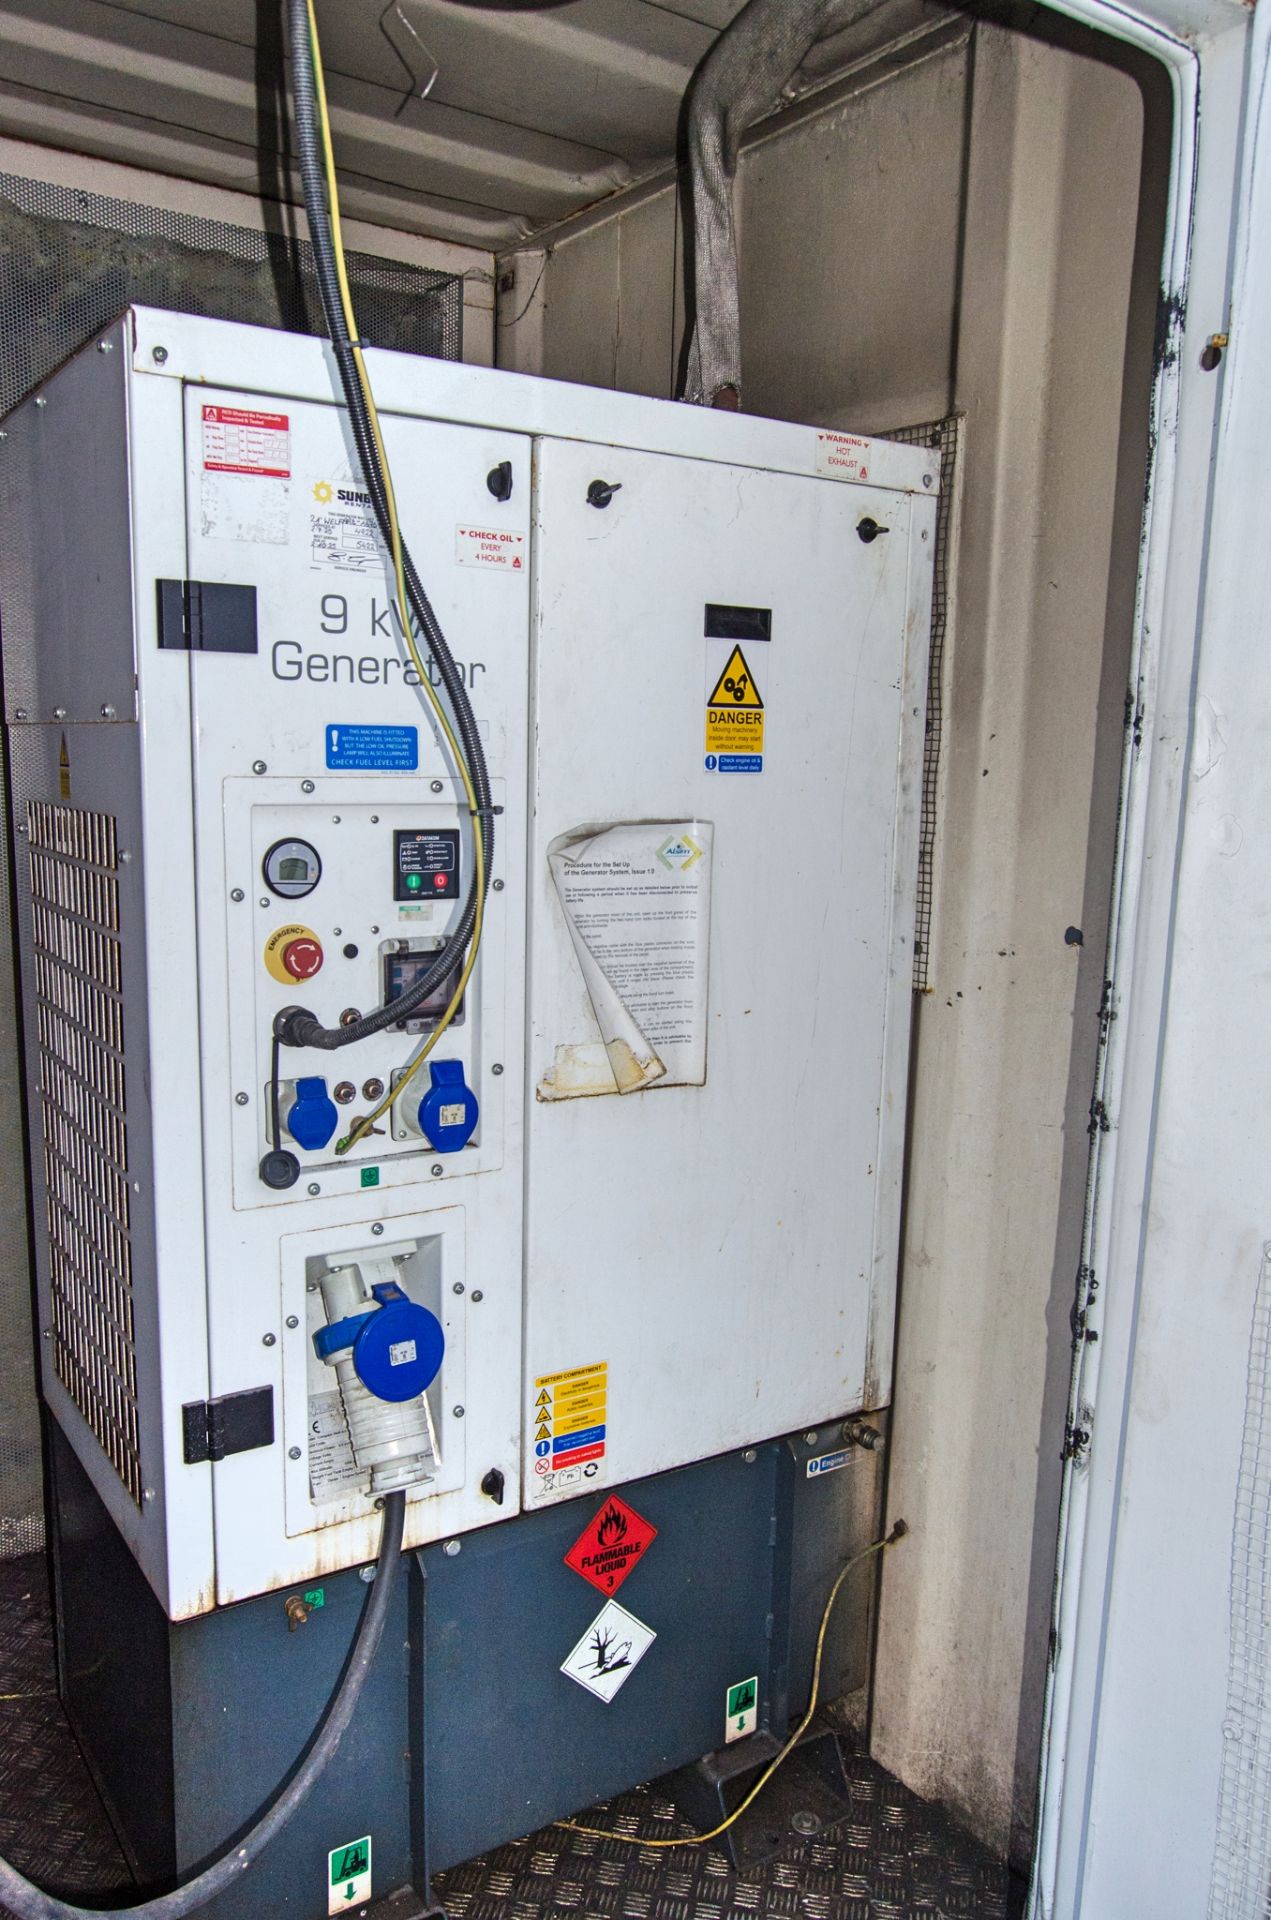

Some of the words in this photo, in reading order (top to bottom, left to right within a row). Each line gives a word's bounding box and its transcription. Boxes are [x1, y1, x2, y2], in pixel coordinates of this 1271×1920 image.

[826, 434, 862, 446] WARNING
[836, 446, 851, 456] HOT
[828, 456, 858, 468] EXHAUST
[337, 489, 371, 504] SUNB
[469, 530, 498, 540] CHECK
[499, 534, 514, 542] OIL
[481, 543, 501, 551] EVERY
[481, 554, 506, 563] HOURS
[321, 594, 348, 634] 9
[709, 711, 762, 725] DANGER
[712, 726, 731, 734] Moving
[268, 927, 305, 951] EMERGENCY
[540, 1375, 562, 1385] BATTERY
[564, 1365, 602, 1378] COMPARTMENT
[581, 1542, 641, 1568] FLAMMABLE
[595, 1557, 627, 1576] LIQUID
[607, 1576, 614, 1587] 3
